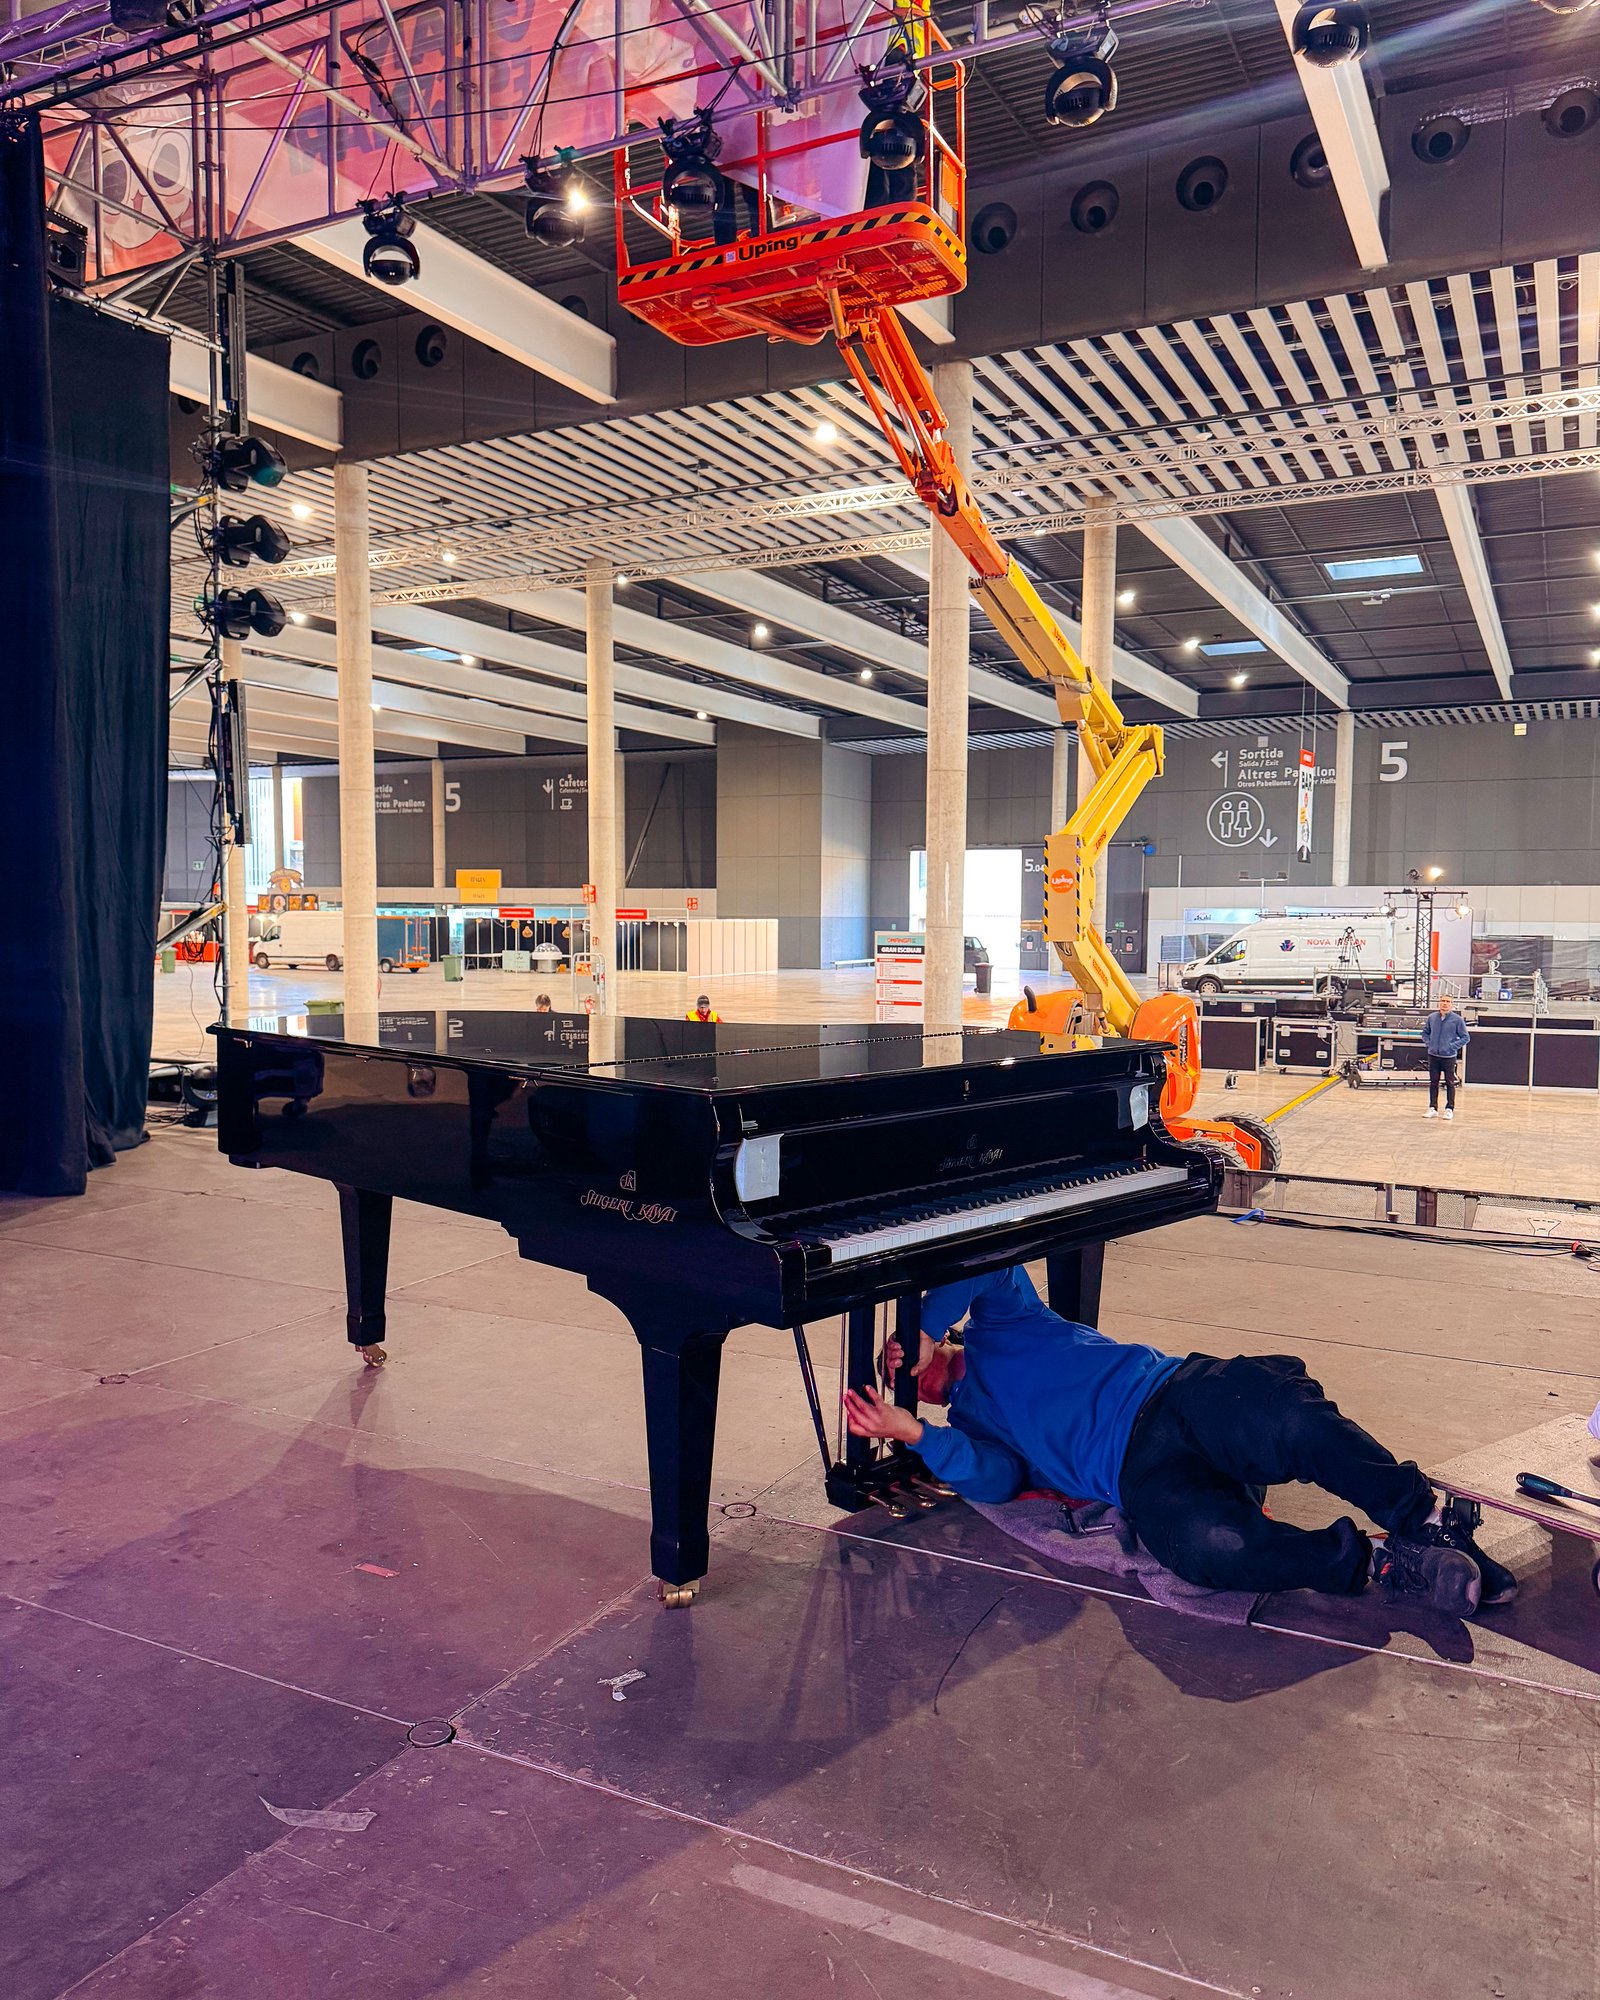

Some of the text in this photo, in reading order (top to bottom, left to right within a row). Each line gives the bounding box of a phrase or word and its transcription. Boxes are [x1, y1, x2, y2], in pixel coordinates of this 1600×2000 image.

[738, 236, 799, 261] Uping
[1239, 747, 1284, 760] Sortida
[1379, 741, 1408, 782] 5
[1238, 760, 1259, 768] Salida
[559, 778, 588, 787] Cafeter
[1238, 769, 1278, 780] Altres
[445, 782, 461, 812] 5
[580, 1189, 679, 1224] SHIGERU KAWAI
